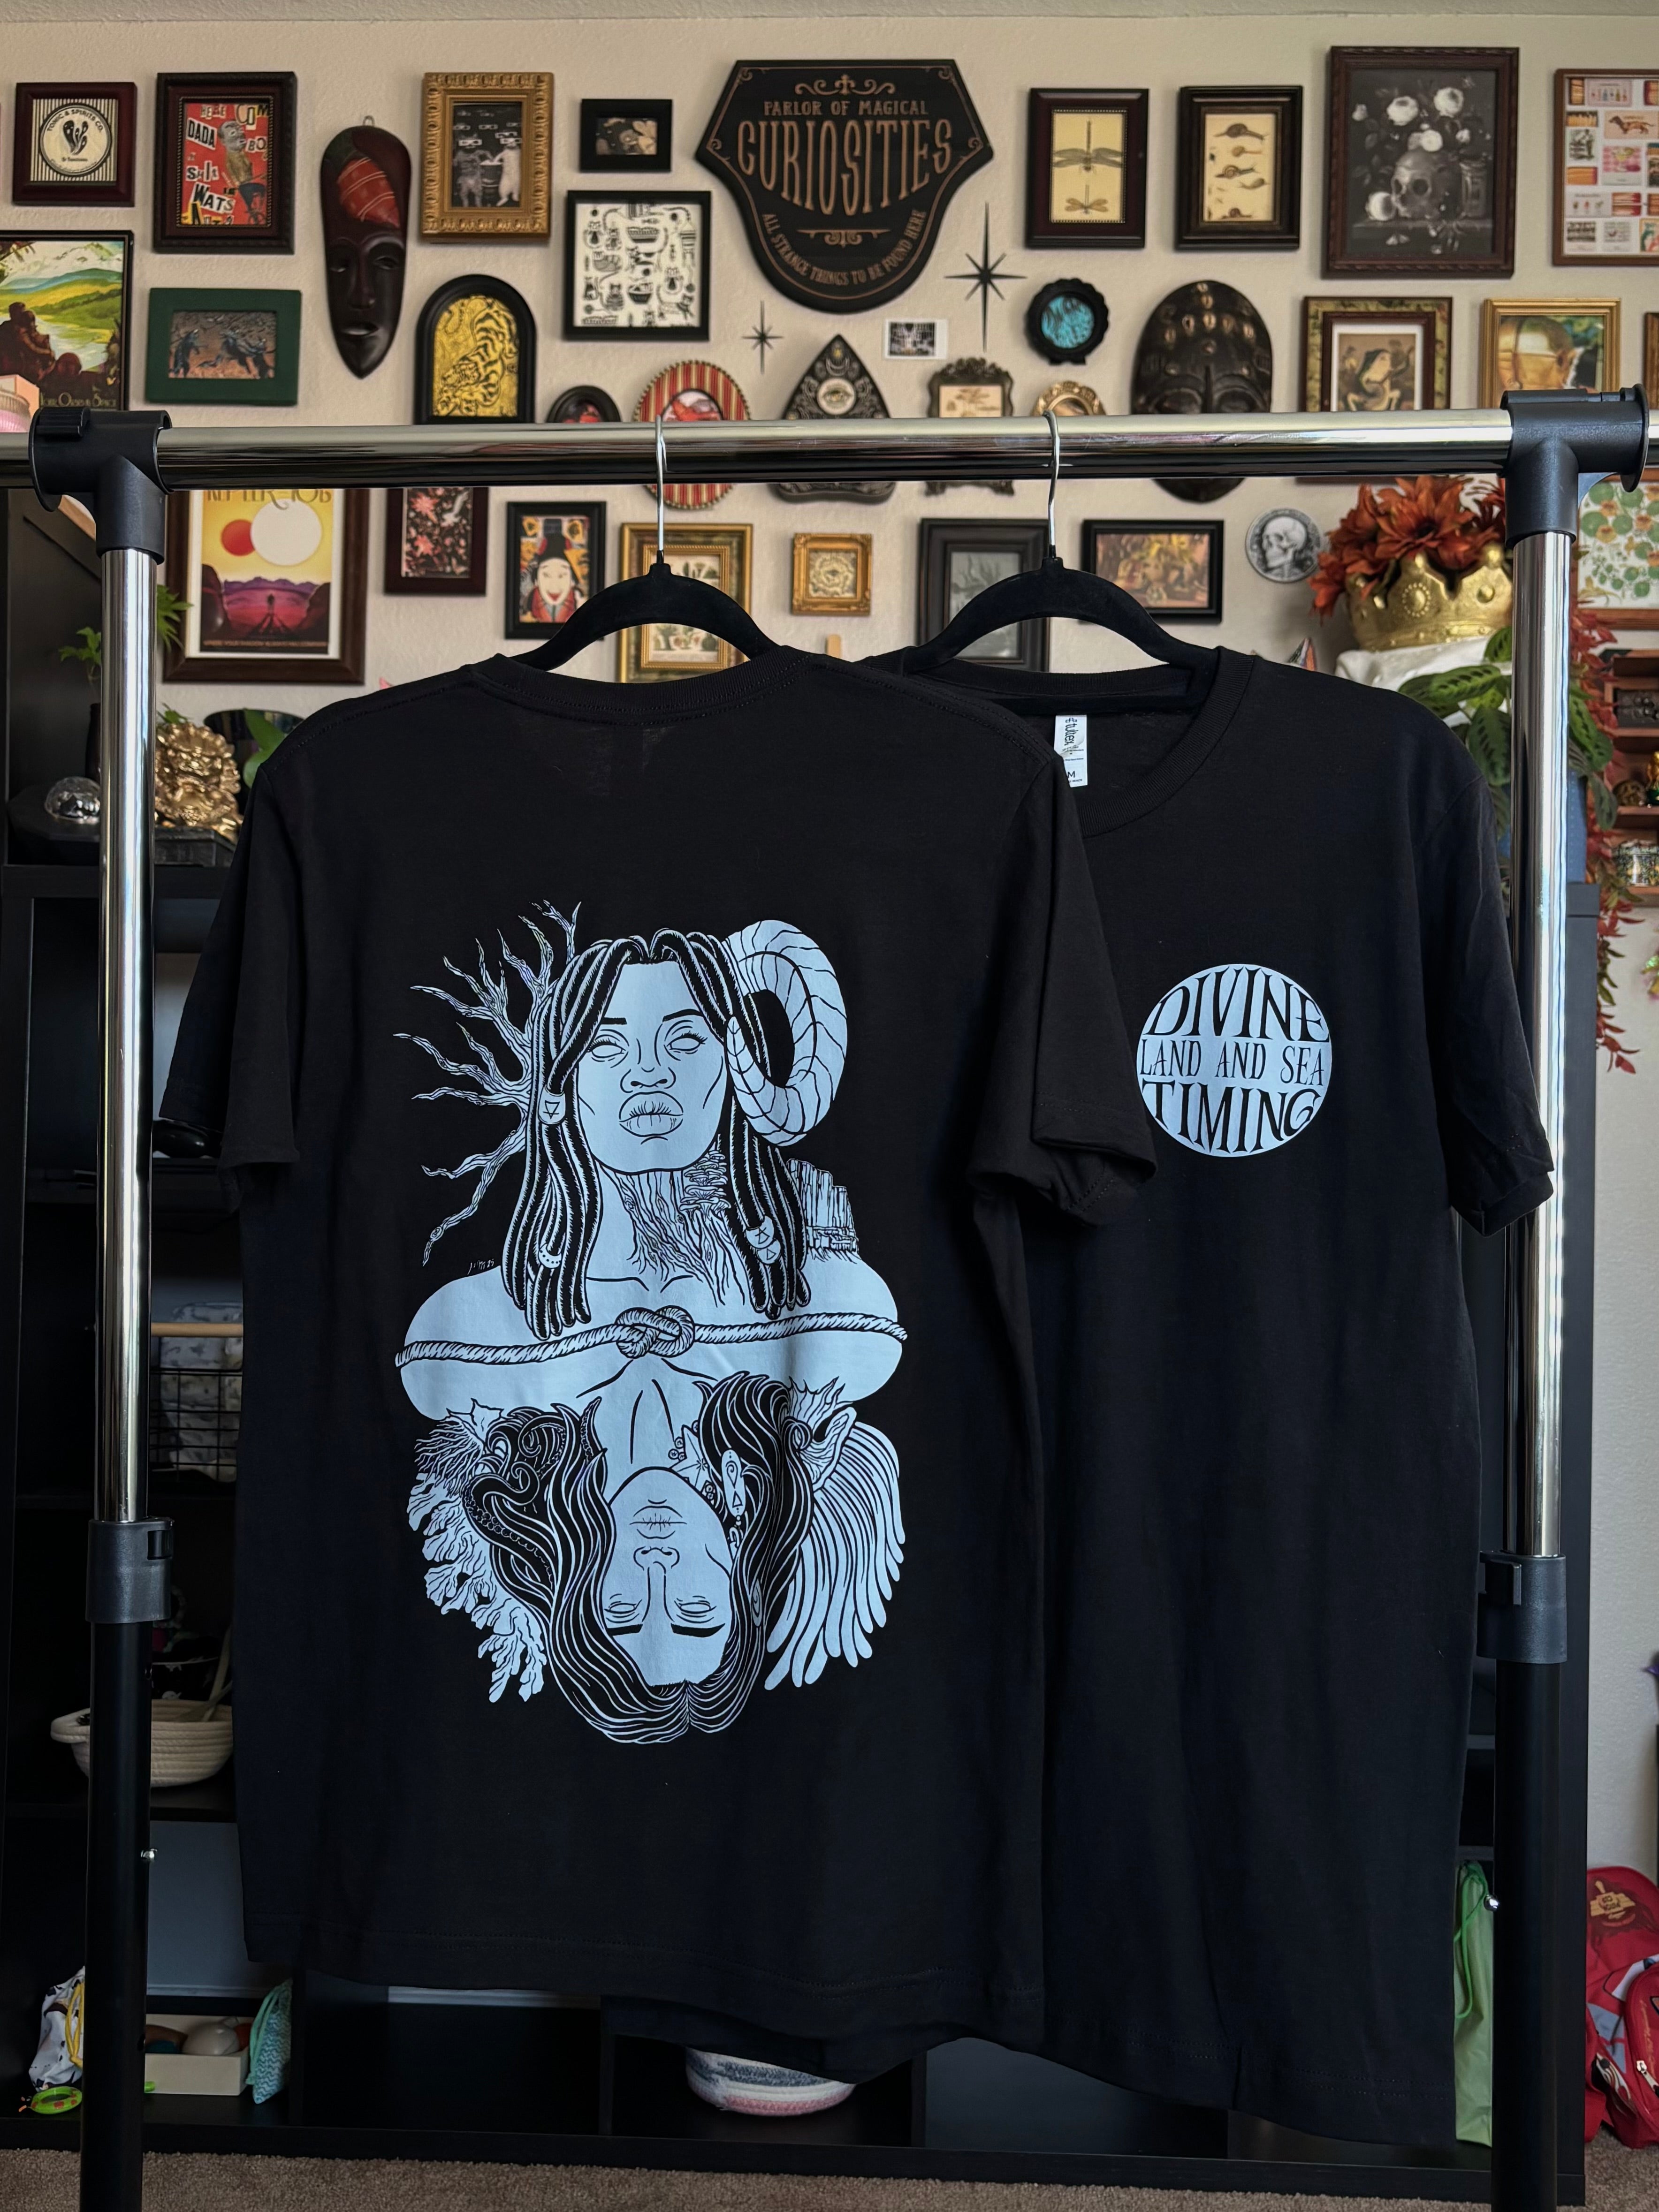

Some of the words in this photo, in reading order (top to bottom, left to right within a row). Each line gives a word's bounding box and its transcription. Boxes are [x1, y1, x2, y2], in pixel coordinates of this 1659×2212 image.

[46, 113, 64, 132] TONIC
[71, 109, 96, 121] SPIRITS
[764, 101, 822, 116] PARLOR
[830, 101, 851, 115] OF
[859, 100, 928, 115] MAGICAL
[188, 119, 215, 148] DADA
[738, 119, 952, 216] CURIOSITIES
[762, 213, 780, 234] ALL
[771, 234, 812, 276] STRANGE
[809, 266, 849, 286] THINGS
[850, 269, 867, 285] TO
[868, 263, 885, 280] BE
[881, 239, 913, 272] FOUND
[903, 209, 927, 240] HERE
[1064, 723, 1079, 746] tultex
[1143, 966, 1330, 1043] DIVINE
[1140, 1039, 1202, 1077] LAND
[1215, 1041, 1266, 1080] AND
[1280, 1045, 1324, 1086] SEA
[1142, 1078, 1321, 1154] TIMING
